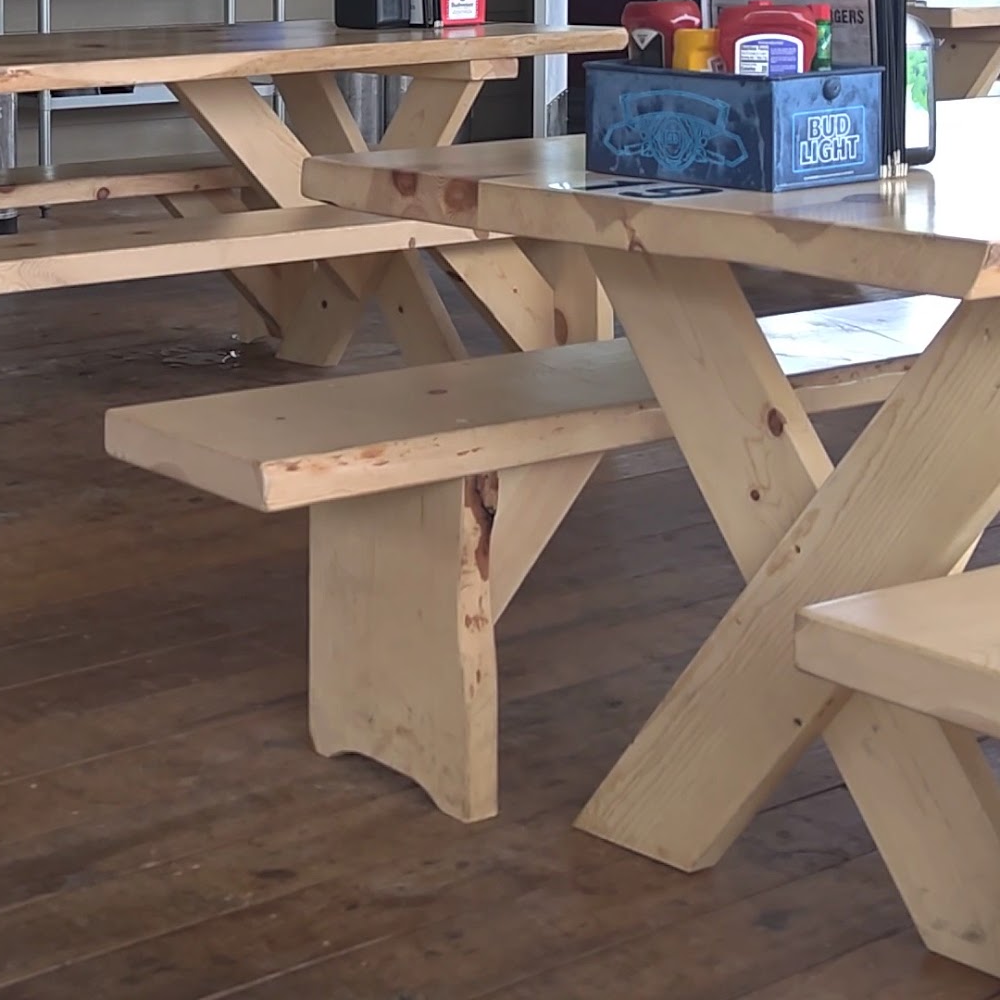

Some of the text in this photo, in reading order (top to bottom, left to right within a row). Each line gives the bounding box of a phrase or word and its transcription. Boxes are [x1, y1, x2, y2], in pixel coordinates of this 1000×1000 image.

[830, 8, 865, 25] GERS
[807, 112, 851, 141] BUD
[800, 134, 860, 166] LIGHT
